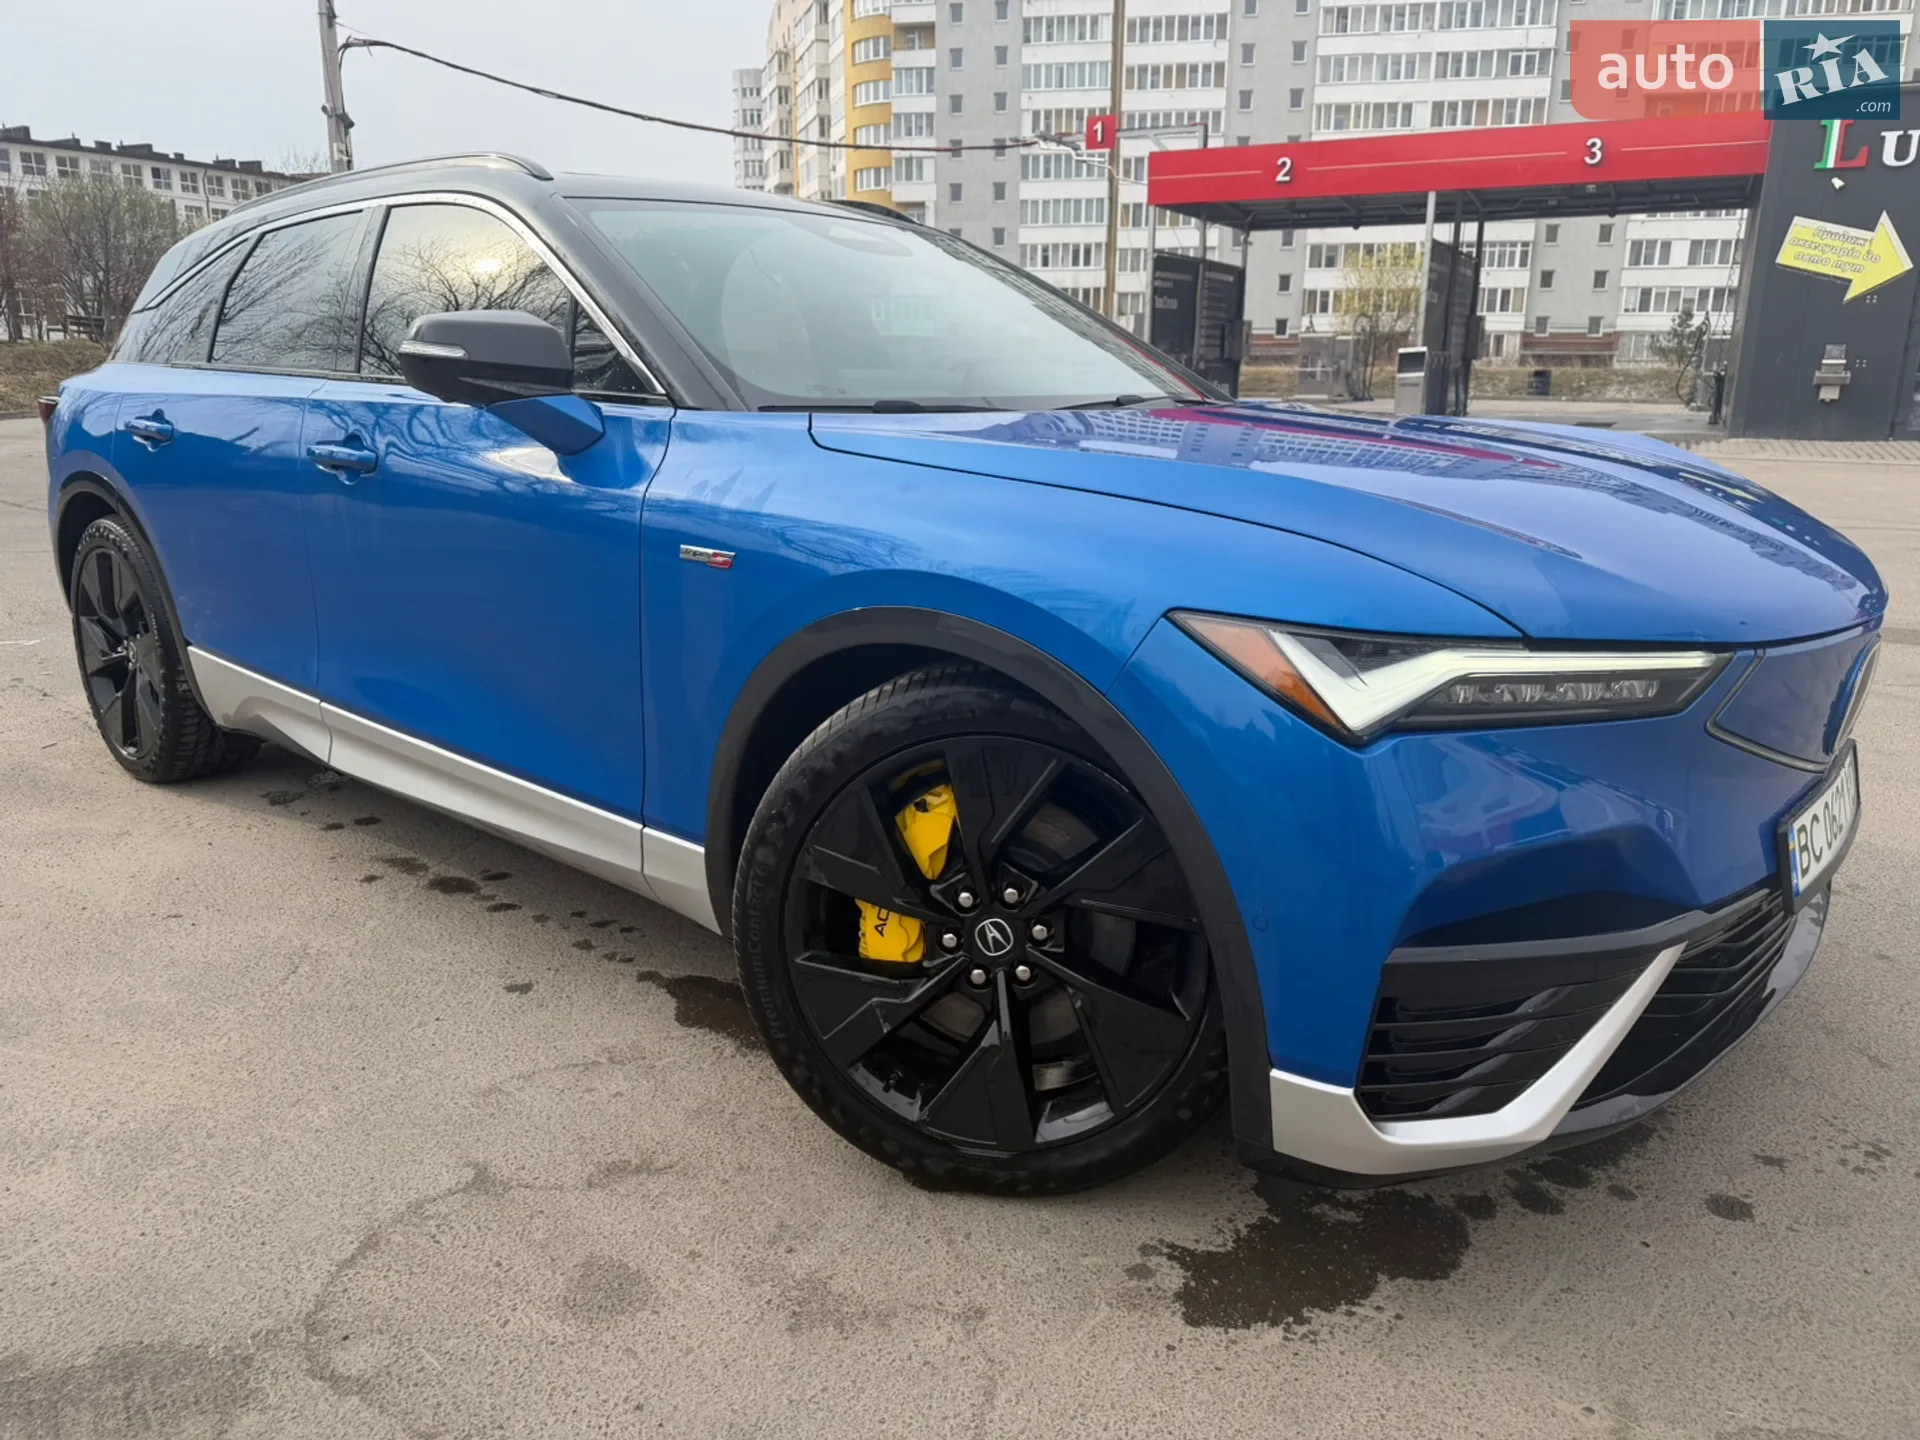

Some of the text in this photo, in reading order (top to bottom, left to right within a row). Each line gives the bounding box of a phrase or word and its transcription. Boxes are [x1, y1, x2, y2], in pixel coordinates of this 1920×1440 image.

[1093, 121, 1103, 144] 1
[1584, 137, 1603, 165] 3
[1275, 157, 1292, 182] 2
[1797, 813, 1823, 879] BC
